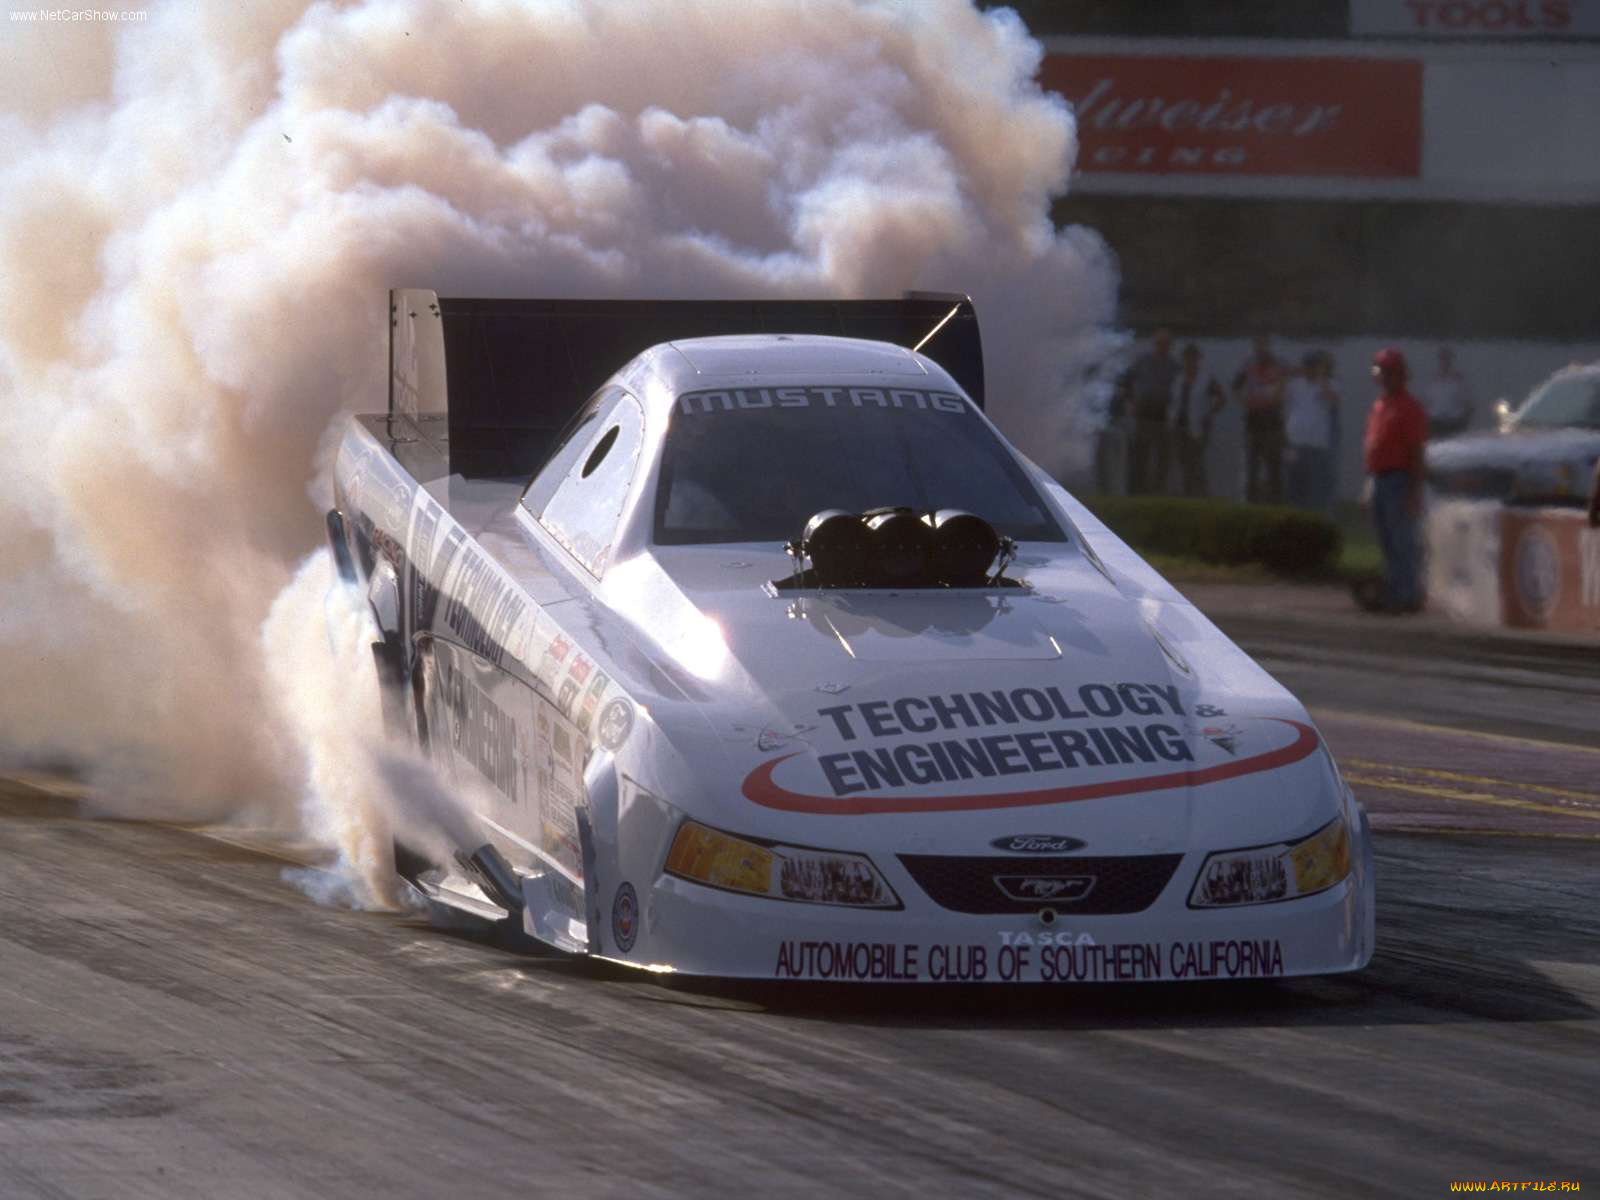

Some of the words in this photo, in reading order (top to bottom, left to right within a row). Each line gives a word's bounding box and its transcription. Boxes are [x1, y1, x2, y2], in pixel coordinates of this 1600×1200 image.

[1407, 0, 1572, 28] TOOLS
[1074, 79, 1343, 138] weiser
[679, 387, 966, 415] MUSTANG
[818, 683, 1186, 741] TECHNOLOGY
[1195, 703, 1226, 718] &
[818, 724, 1195, 796] ENGINEERING
[1010, 836, 1068, 850] Ford
[998, 930, 1096, 945] TASCA
[776, 940, 918, 981] AUTOMOBILE
[928, 944, 987, 982] CLUB
[998, 944, 1031, 983] OF
[1040, 944, 1161, 982] SOUTHERN
[1170, 940, 1283, 980] CALIFORNIA
